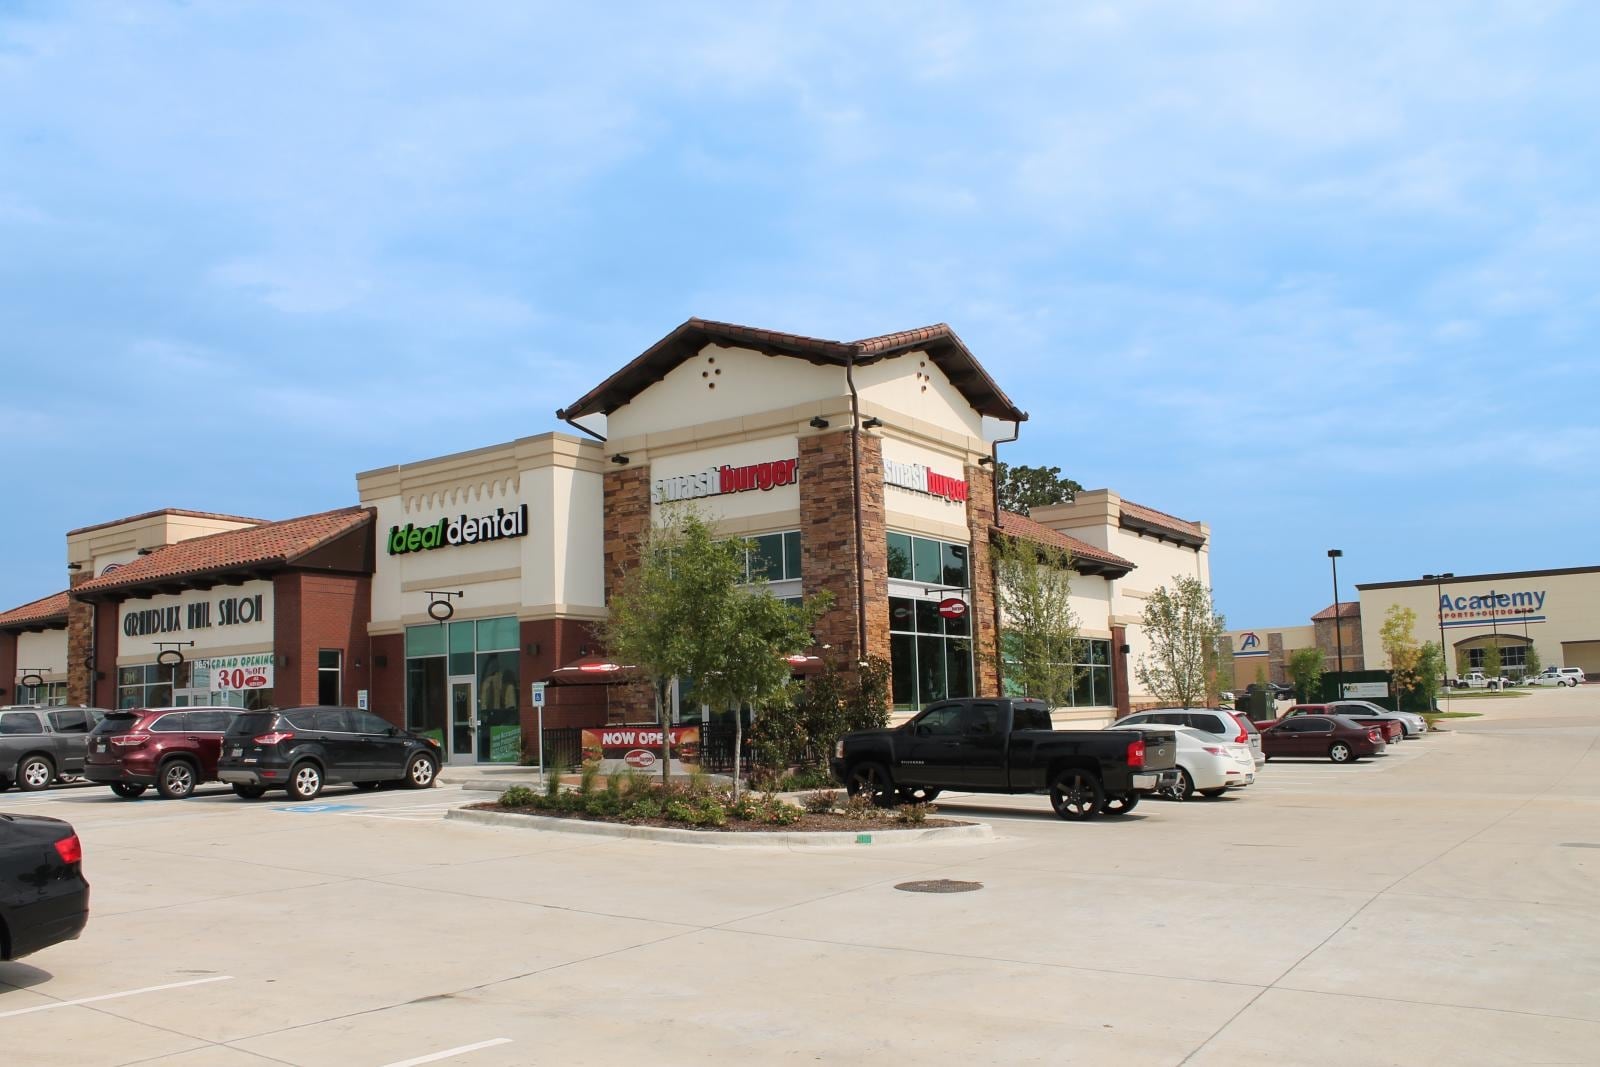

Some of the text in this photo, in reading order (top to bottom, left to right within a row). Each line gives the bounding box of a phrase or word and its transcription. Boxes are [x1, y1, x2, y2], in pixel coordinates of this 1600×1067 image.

[651, 458, 798, 505] smashburger
[387, 504, 528, 555] ideal dental
[1439, 590, 1546, 611] Academy
[187, 602, 212, 629] NAIL
[218, 594, 263, 626] SALON
[211, 657, 239, 670] GRAND
[218, 668, 245, 689] 30
[602, 732, 635, 745] NOW
